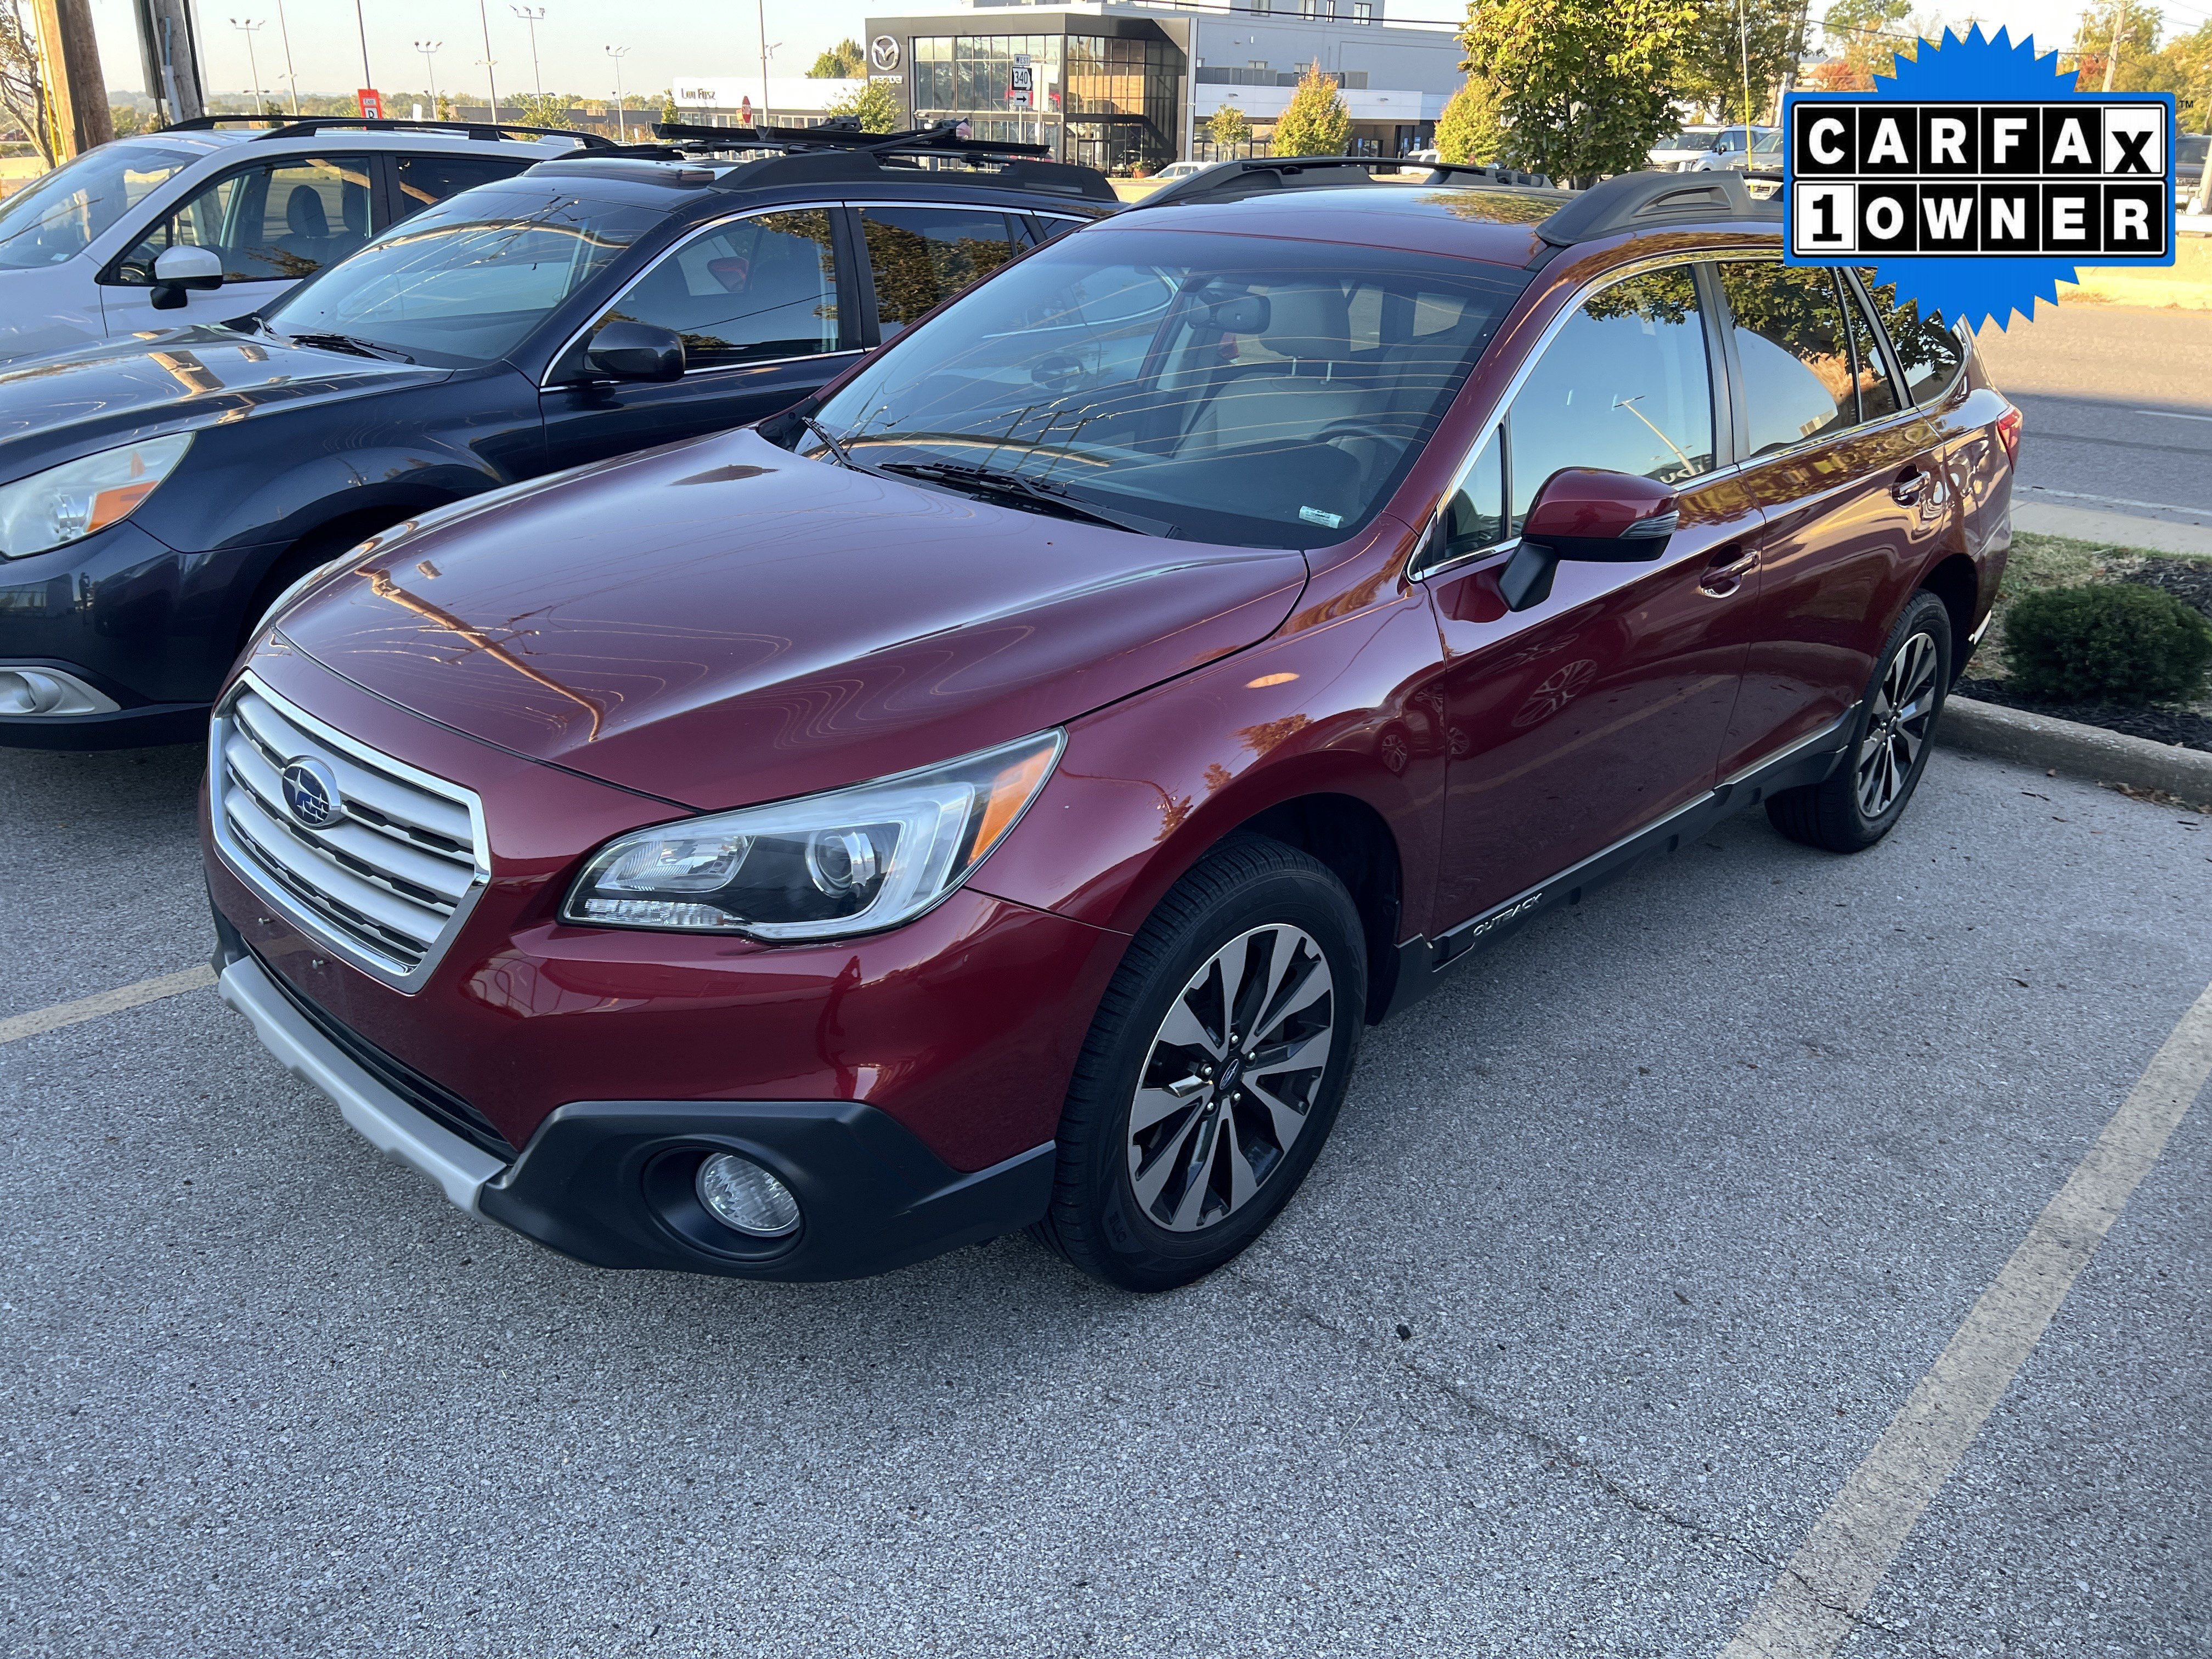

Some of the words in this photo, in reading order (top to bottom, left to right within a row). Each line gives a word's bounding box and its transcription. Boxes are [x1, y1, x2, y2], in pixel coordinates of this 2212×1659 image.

[1016, 56, 1029, 64] WEST
[1015, 71, 1028, 84] 340
[1473, 893, 1542, 937] OUTBACK
